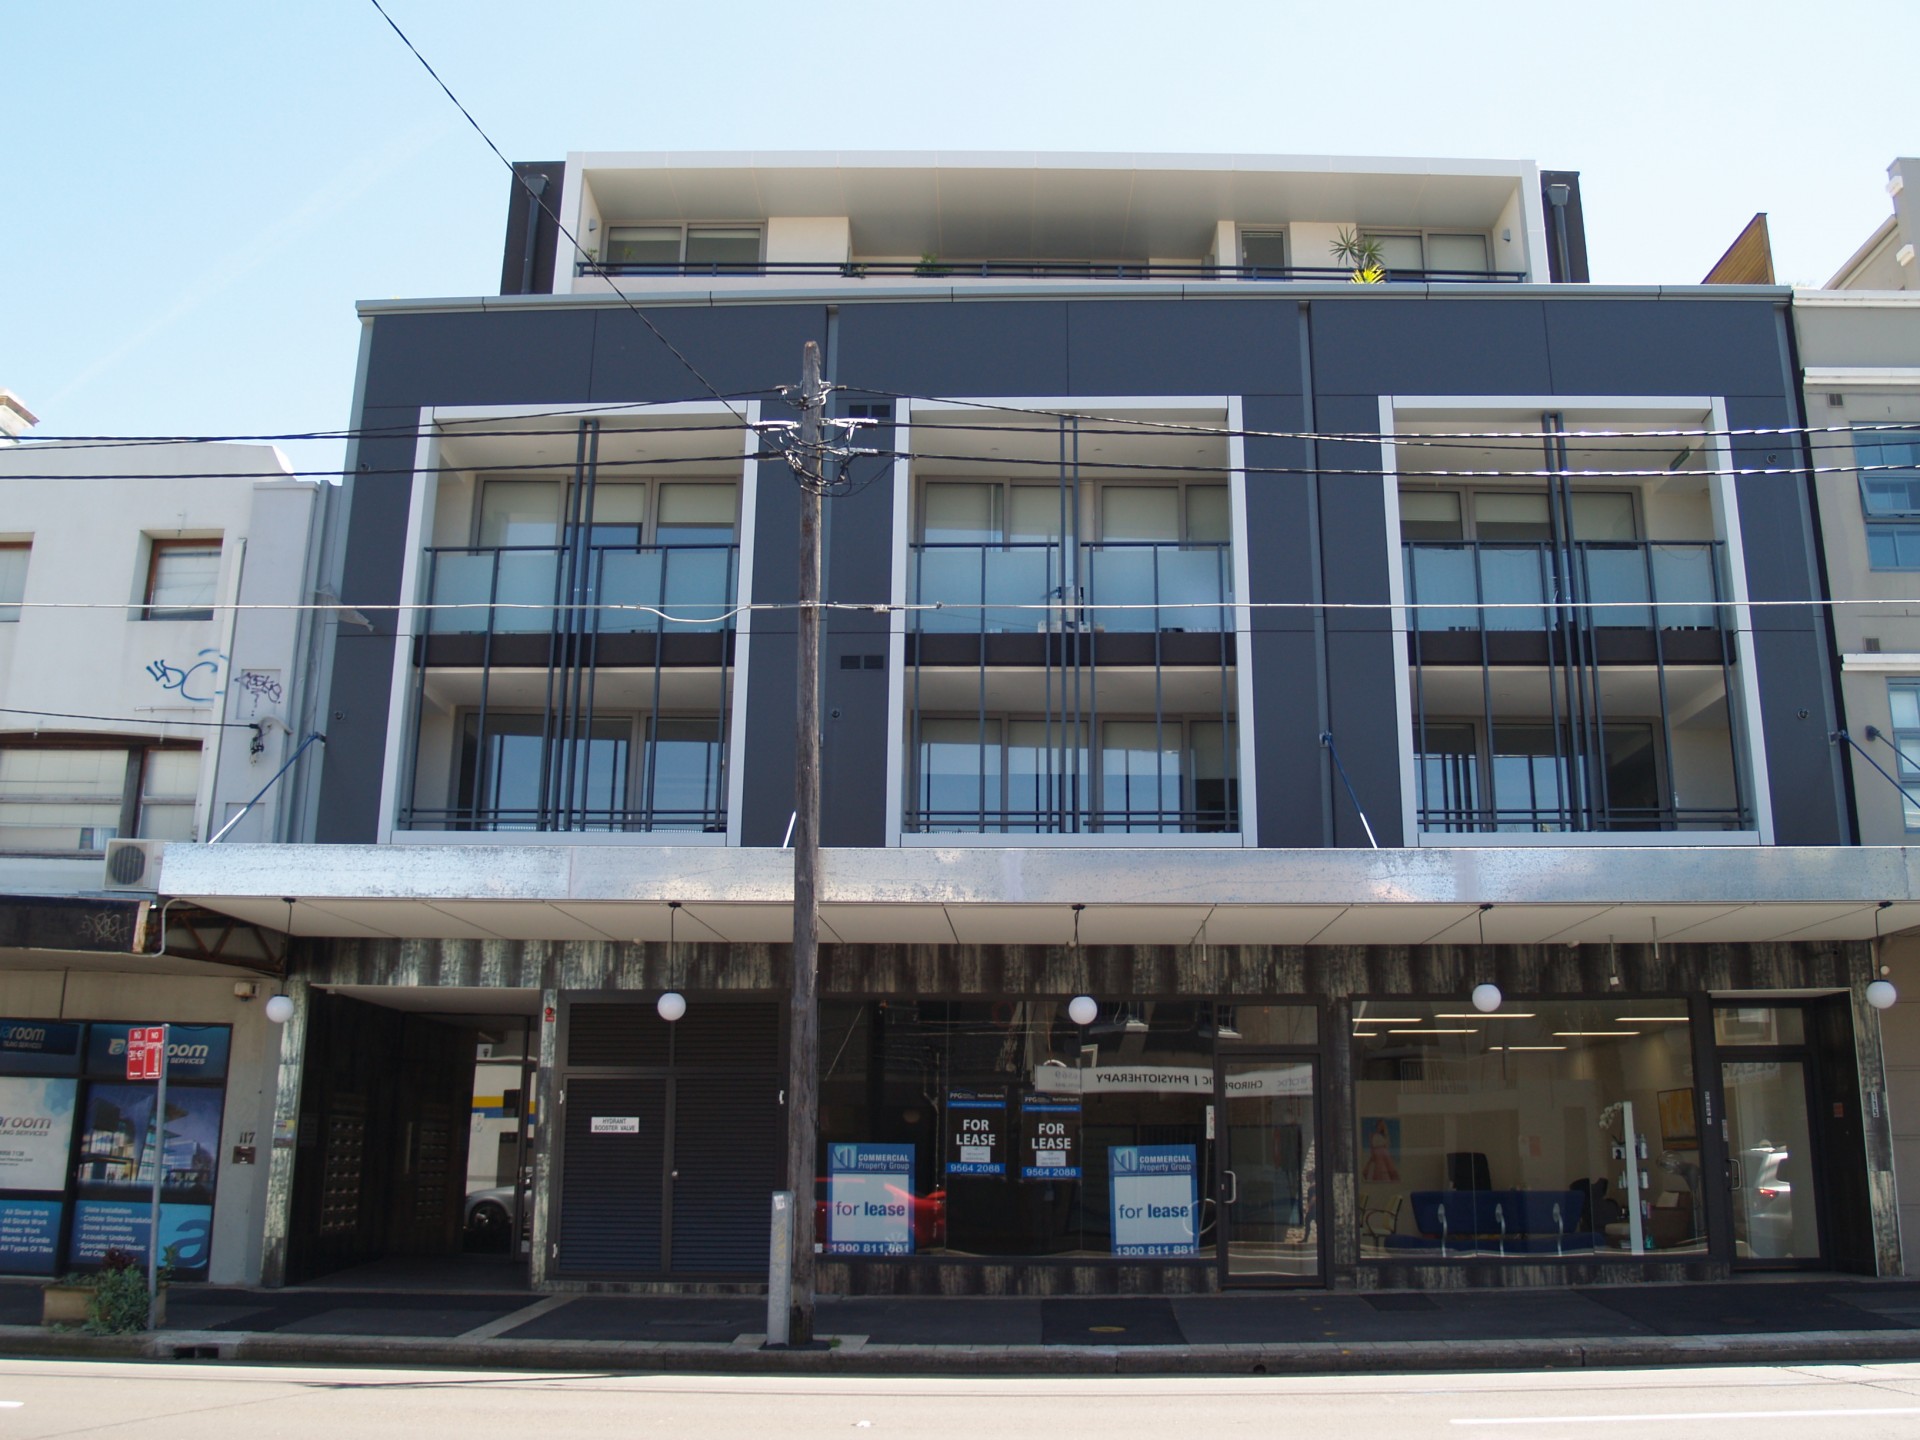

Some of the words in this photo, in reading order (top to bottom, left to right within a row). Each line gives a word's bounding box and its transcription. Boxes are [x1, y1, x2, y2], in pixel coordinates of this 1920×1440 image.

[134, 1031, 142, 1039] NO
[170, 1057, 205, 1065] SERVICES
[963, 1120, 989, 1130] FOR
[1038, 1123, 1064, 1134] FOR
[239, 1132, 256, 1144] 117
[956, 1134, 996, 1146] LEASE
[1032, 1138, 1071, 1150] LEASE
[858, 1154, 909, 1162] COMMERCIAL
[1140, 1154, 1191, 1163] COMMERCIAL
[858, 1162, 888, 1170] Property
[889, 1162, 910, 1170] Group
[950, 1164, 974, 1172] 9564
[976, 1164, 1000, 1172] 2088
[1140, 1163, 1168, 1172] Property
[1171, 1163, 1192, 1172] Group
[1026, 1168, 1049, 1176] 9564
[1053, 1168, 1076, 1176] 2088
[836, 1201, 860, 1216] for
[864, 1201, 905, 1216] lease
[1119, 1204, 1143, 1219] for
[1148, 1204, 1189, 1218] lease
[832, 1243, 860, 1252] 1300
[863, 1243, 884, 1252] 811
[1116, 1246, 1144, 1256] 1300
[1148, 1245, 1169, 1254] 811
[1173, 1245, 1194, 1254] 881
